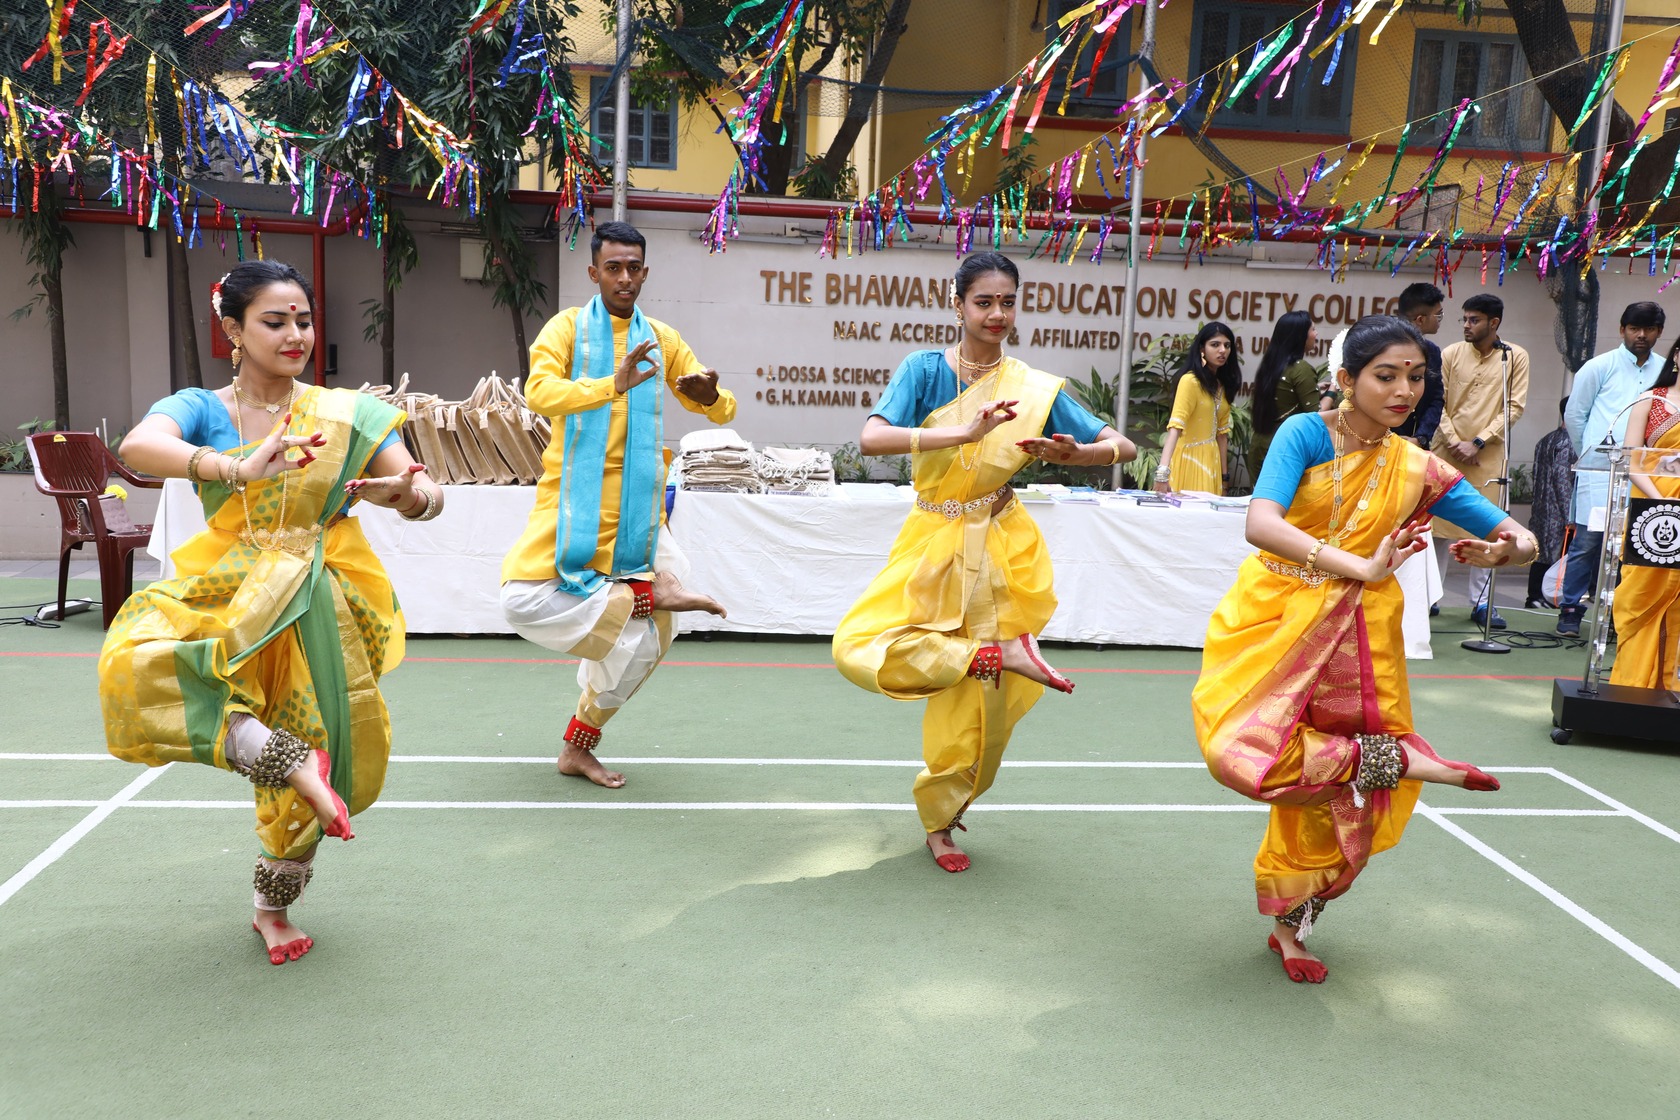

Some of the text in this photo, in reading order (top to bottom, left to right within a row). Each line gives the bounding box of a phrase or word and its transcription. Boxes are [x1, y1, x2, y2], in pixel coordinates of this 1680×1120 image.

[760, 270, 812, 304] THE
[1022, 281, 1177, 318] EDUCATON
[1188, 289, 1299, 322] SOCIETY
[1308, 293, 1400, 325] COLLEG
[833, 321, 881, 341] NAAC
[1007, 326, 1020, 345] &
[1030, 328, 1120, 350] AFFILIATED
[833, 367, 891, 385] SCIENCE
[861, 390, 872, 407] &
